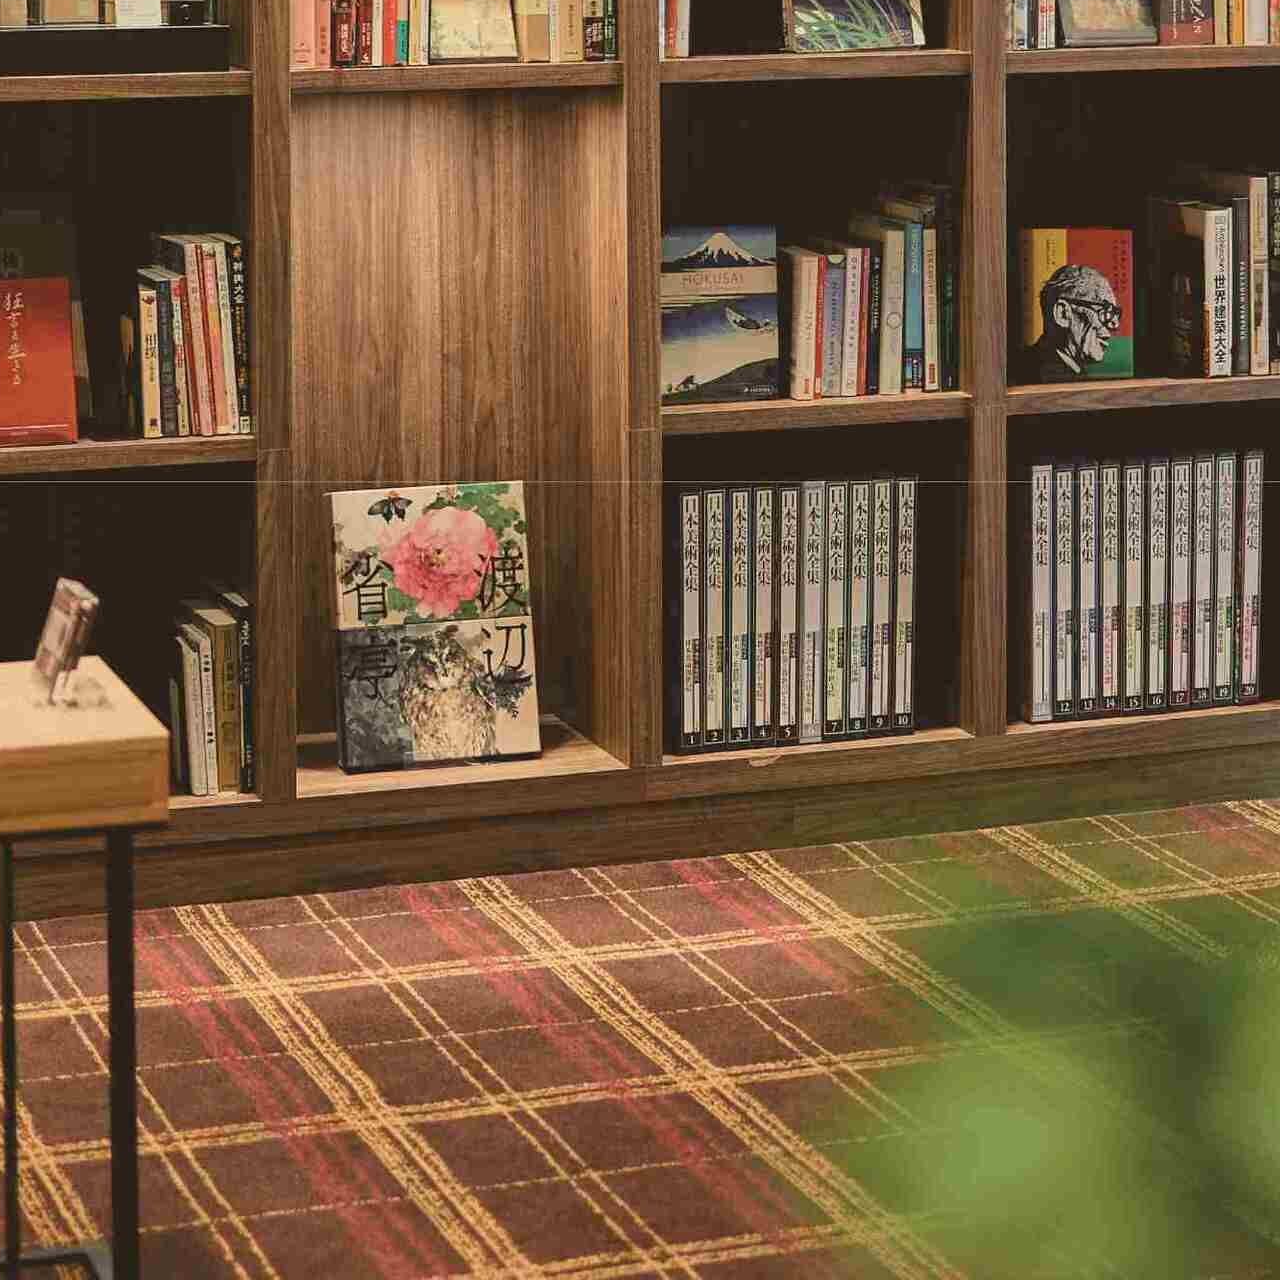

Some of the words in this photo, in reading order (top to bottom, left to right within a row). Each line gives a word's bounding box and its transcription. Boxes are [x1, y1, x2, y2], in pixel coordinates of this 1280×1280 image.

[682, 271, 744, 288] HOKUSAI
[685, 497, 699, 593] 日本美術全集
[707, 494, 723, 589] 日本美術全集
[733, 494, 748, 588] 日本美術全集
[757, 492, 772, 586] 日本美術全集
[782, 493, 796, 586] 日本美術全集
[807, 492, 821, 585] 日本美術全集
[829, 487, 844, 582] 日本美術全集
[854, 485, 868, 579] 日本美術全集
[876, 482, 890, 577] 日本美術全集
[900, 481, 914, 576] 日本美術全集
